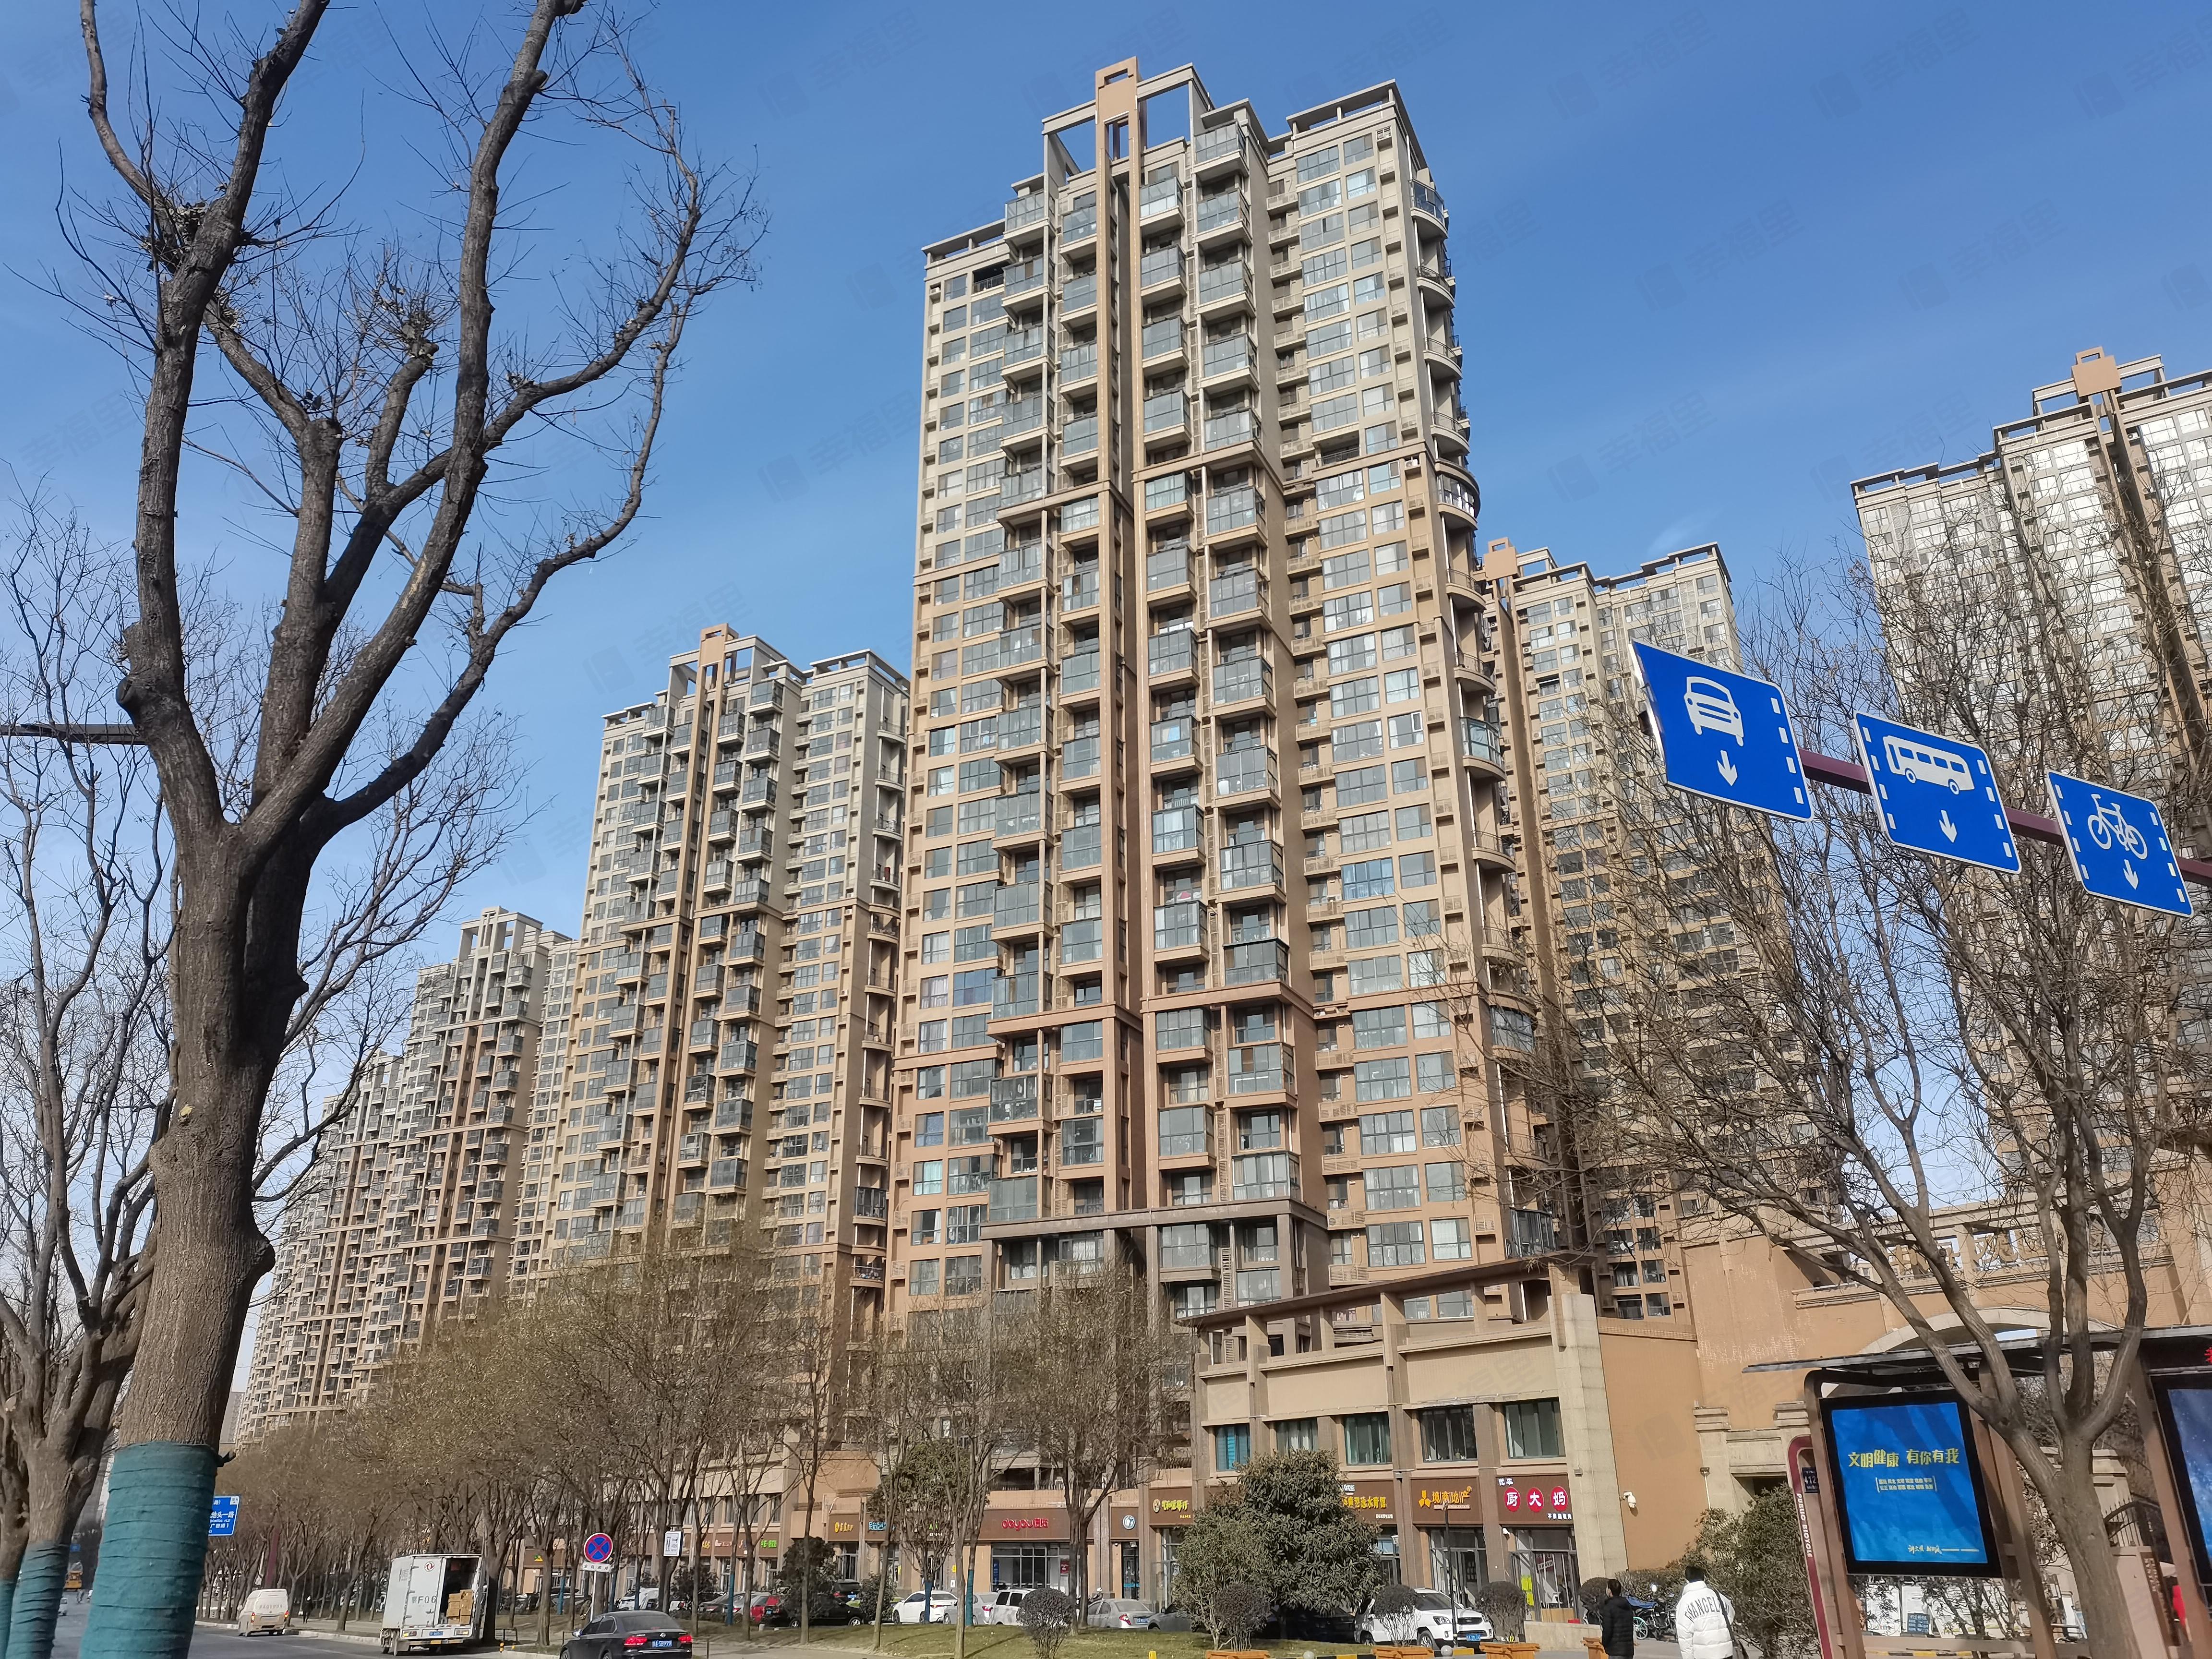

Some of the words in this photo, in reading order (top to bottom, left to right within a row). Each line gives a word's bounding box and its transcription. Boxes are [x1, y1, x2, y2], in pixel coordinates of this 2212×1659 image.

[1848, 1449, 1899, 1467] 文明健康
[1906, 1448, 1960, 1465] 有你有我
[1506, 1491, 1566, 1507] 厨大妈
[1684, 1597, 1729, 1623] EVANGEL
